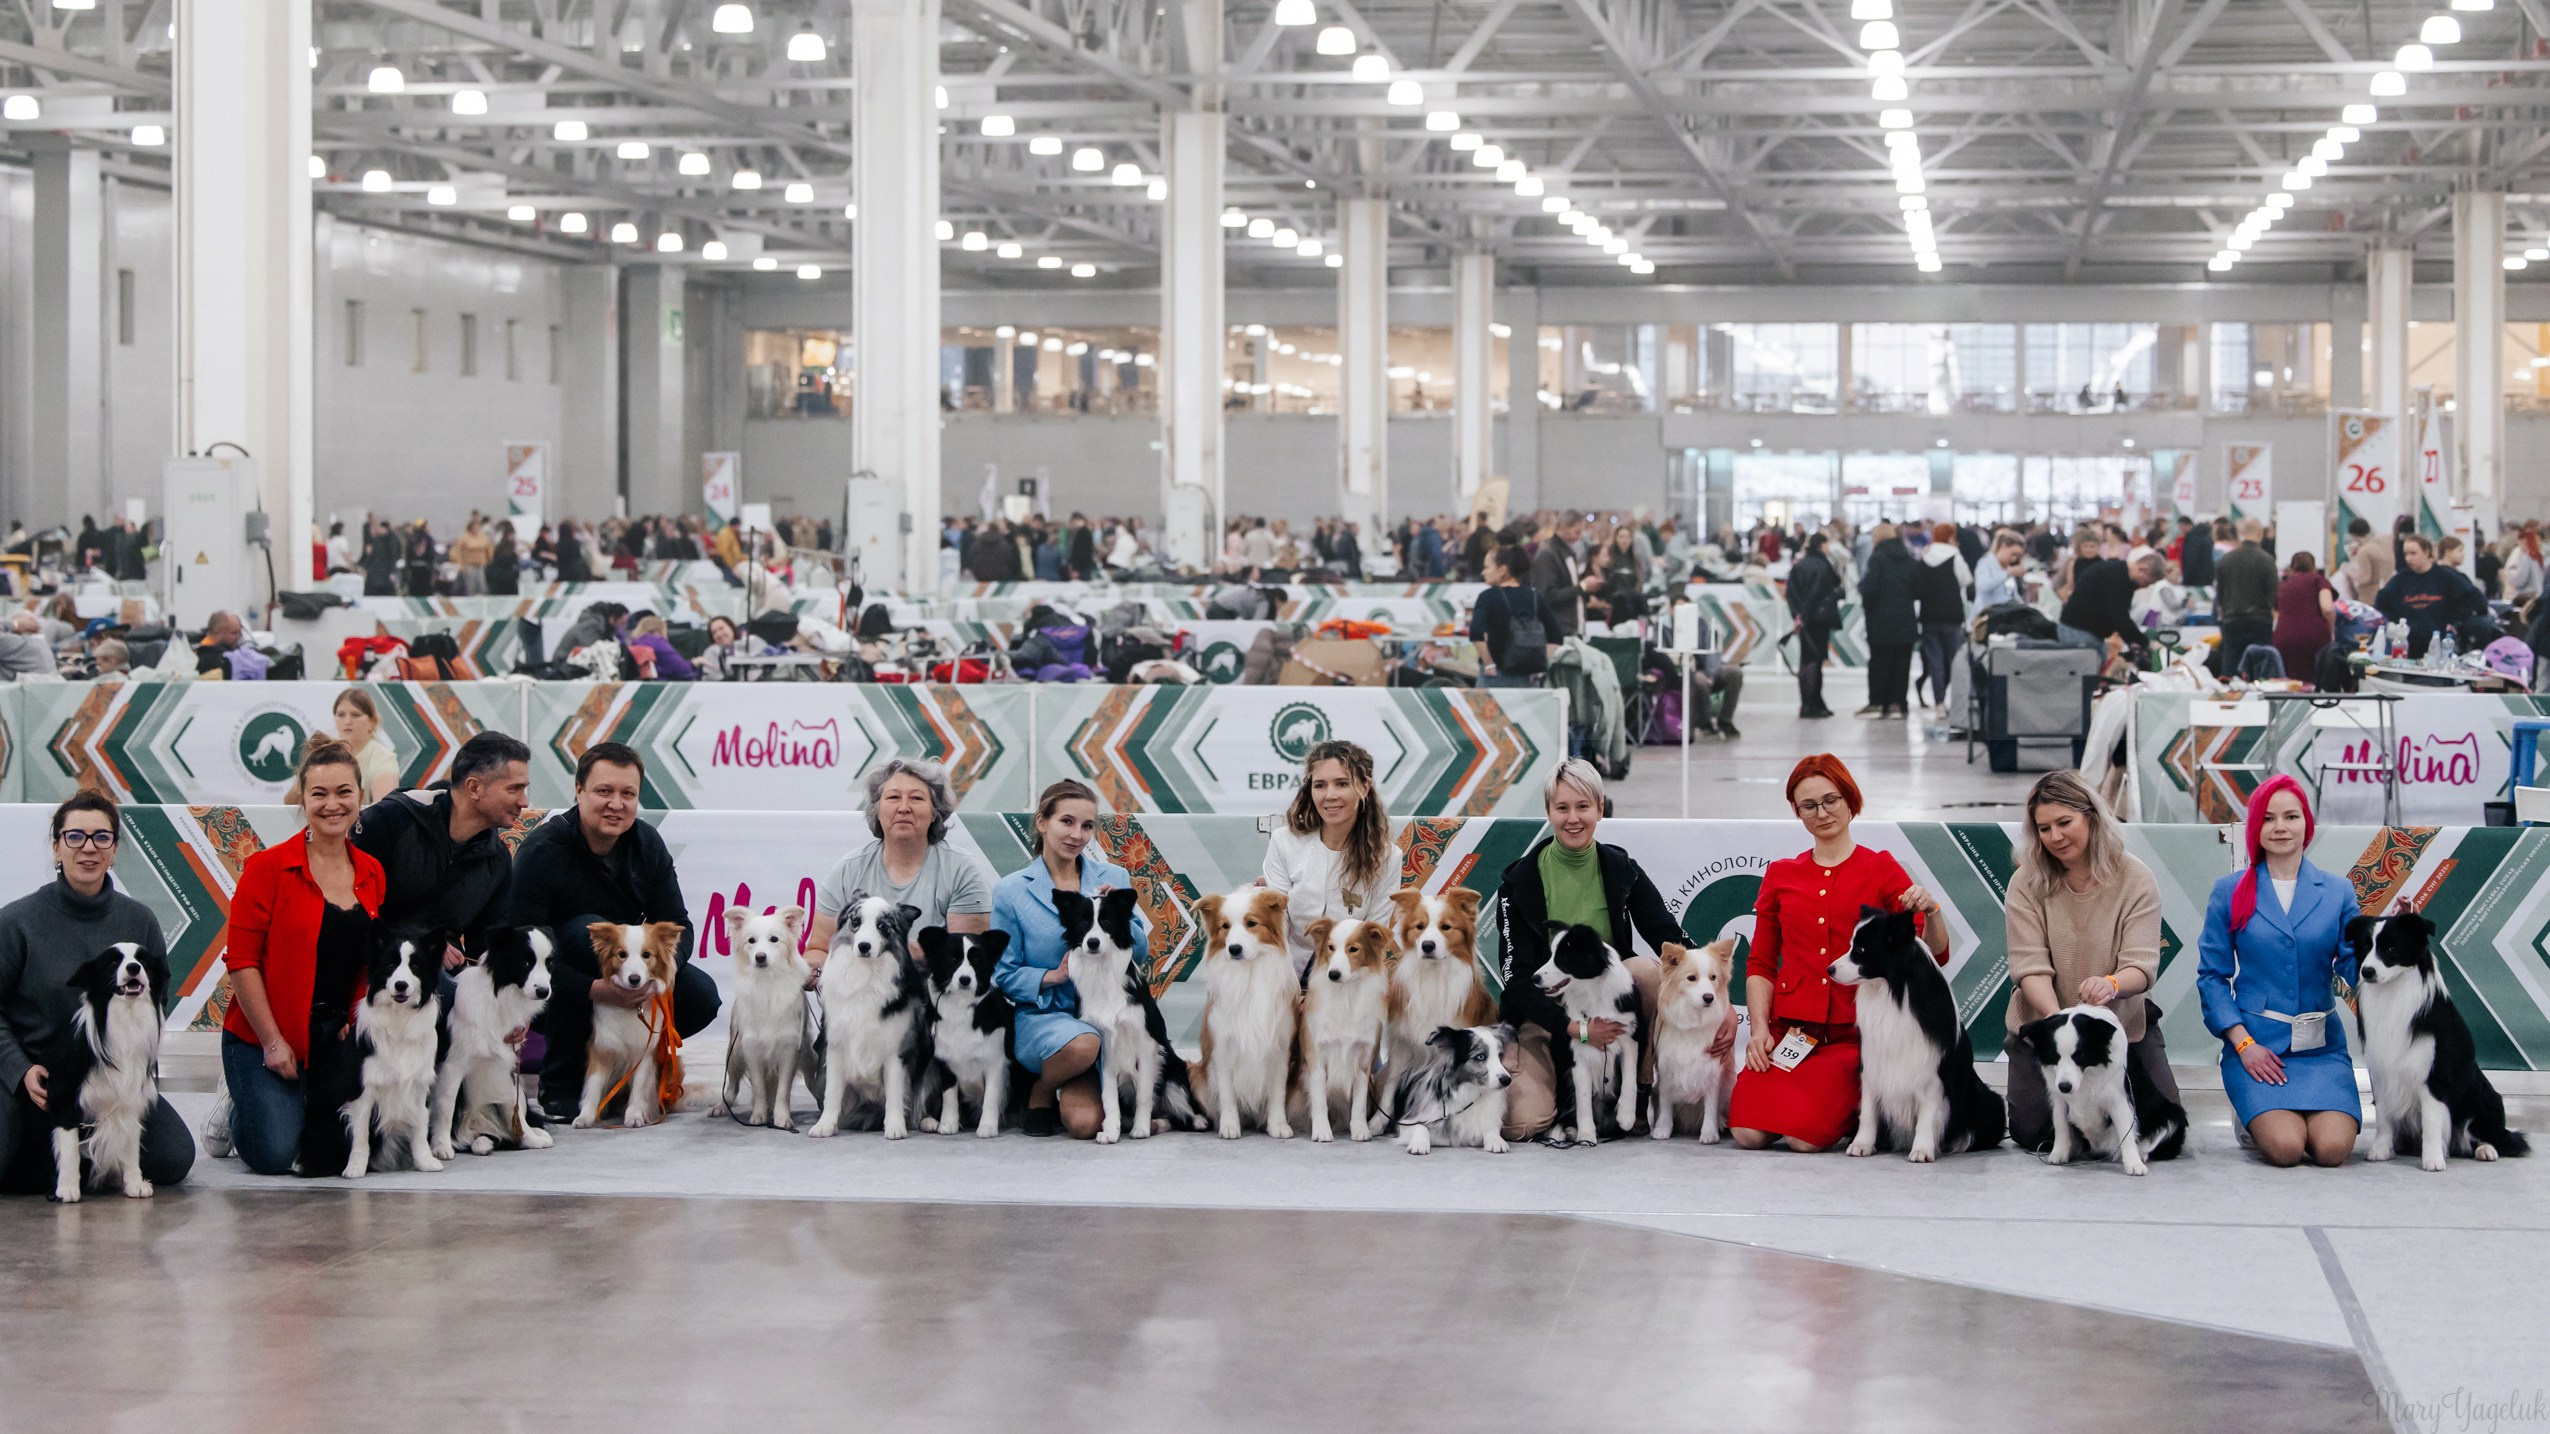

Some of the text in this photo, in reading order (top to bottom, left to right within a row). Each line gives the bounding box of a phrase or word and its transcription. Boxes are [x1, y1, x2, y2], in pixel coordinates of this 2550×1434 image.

[513, 475, 537, 497] 25
[2347, 464, 2385, 493] 26
[2238, 479, 2263, 500] 23
[711, 718, 840, 769] Molina
[1248, 772, 1303, 790] ЕВРА
[143, 840, 158, 860] КУБОК
[1678, 855, 1771, 897] КИНОЛОГИ
[1978, 858, 1995, 879] КУБОК
[2426, 879, 2438, 892] СНГ
[1737, 1013, 1751, 1025] 99
[1780, 1046, 1800, 1060] 139
